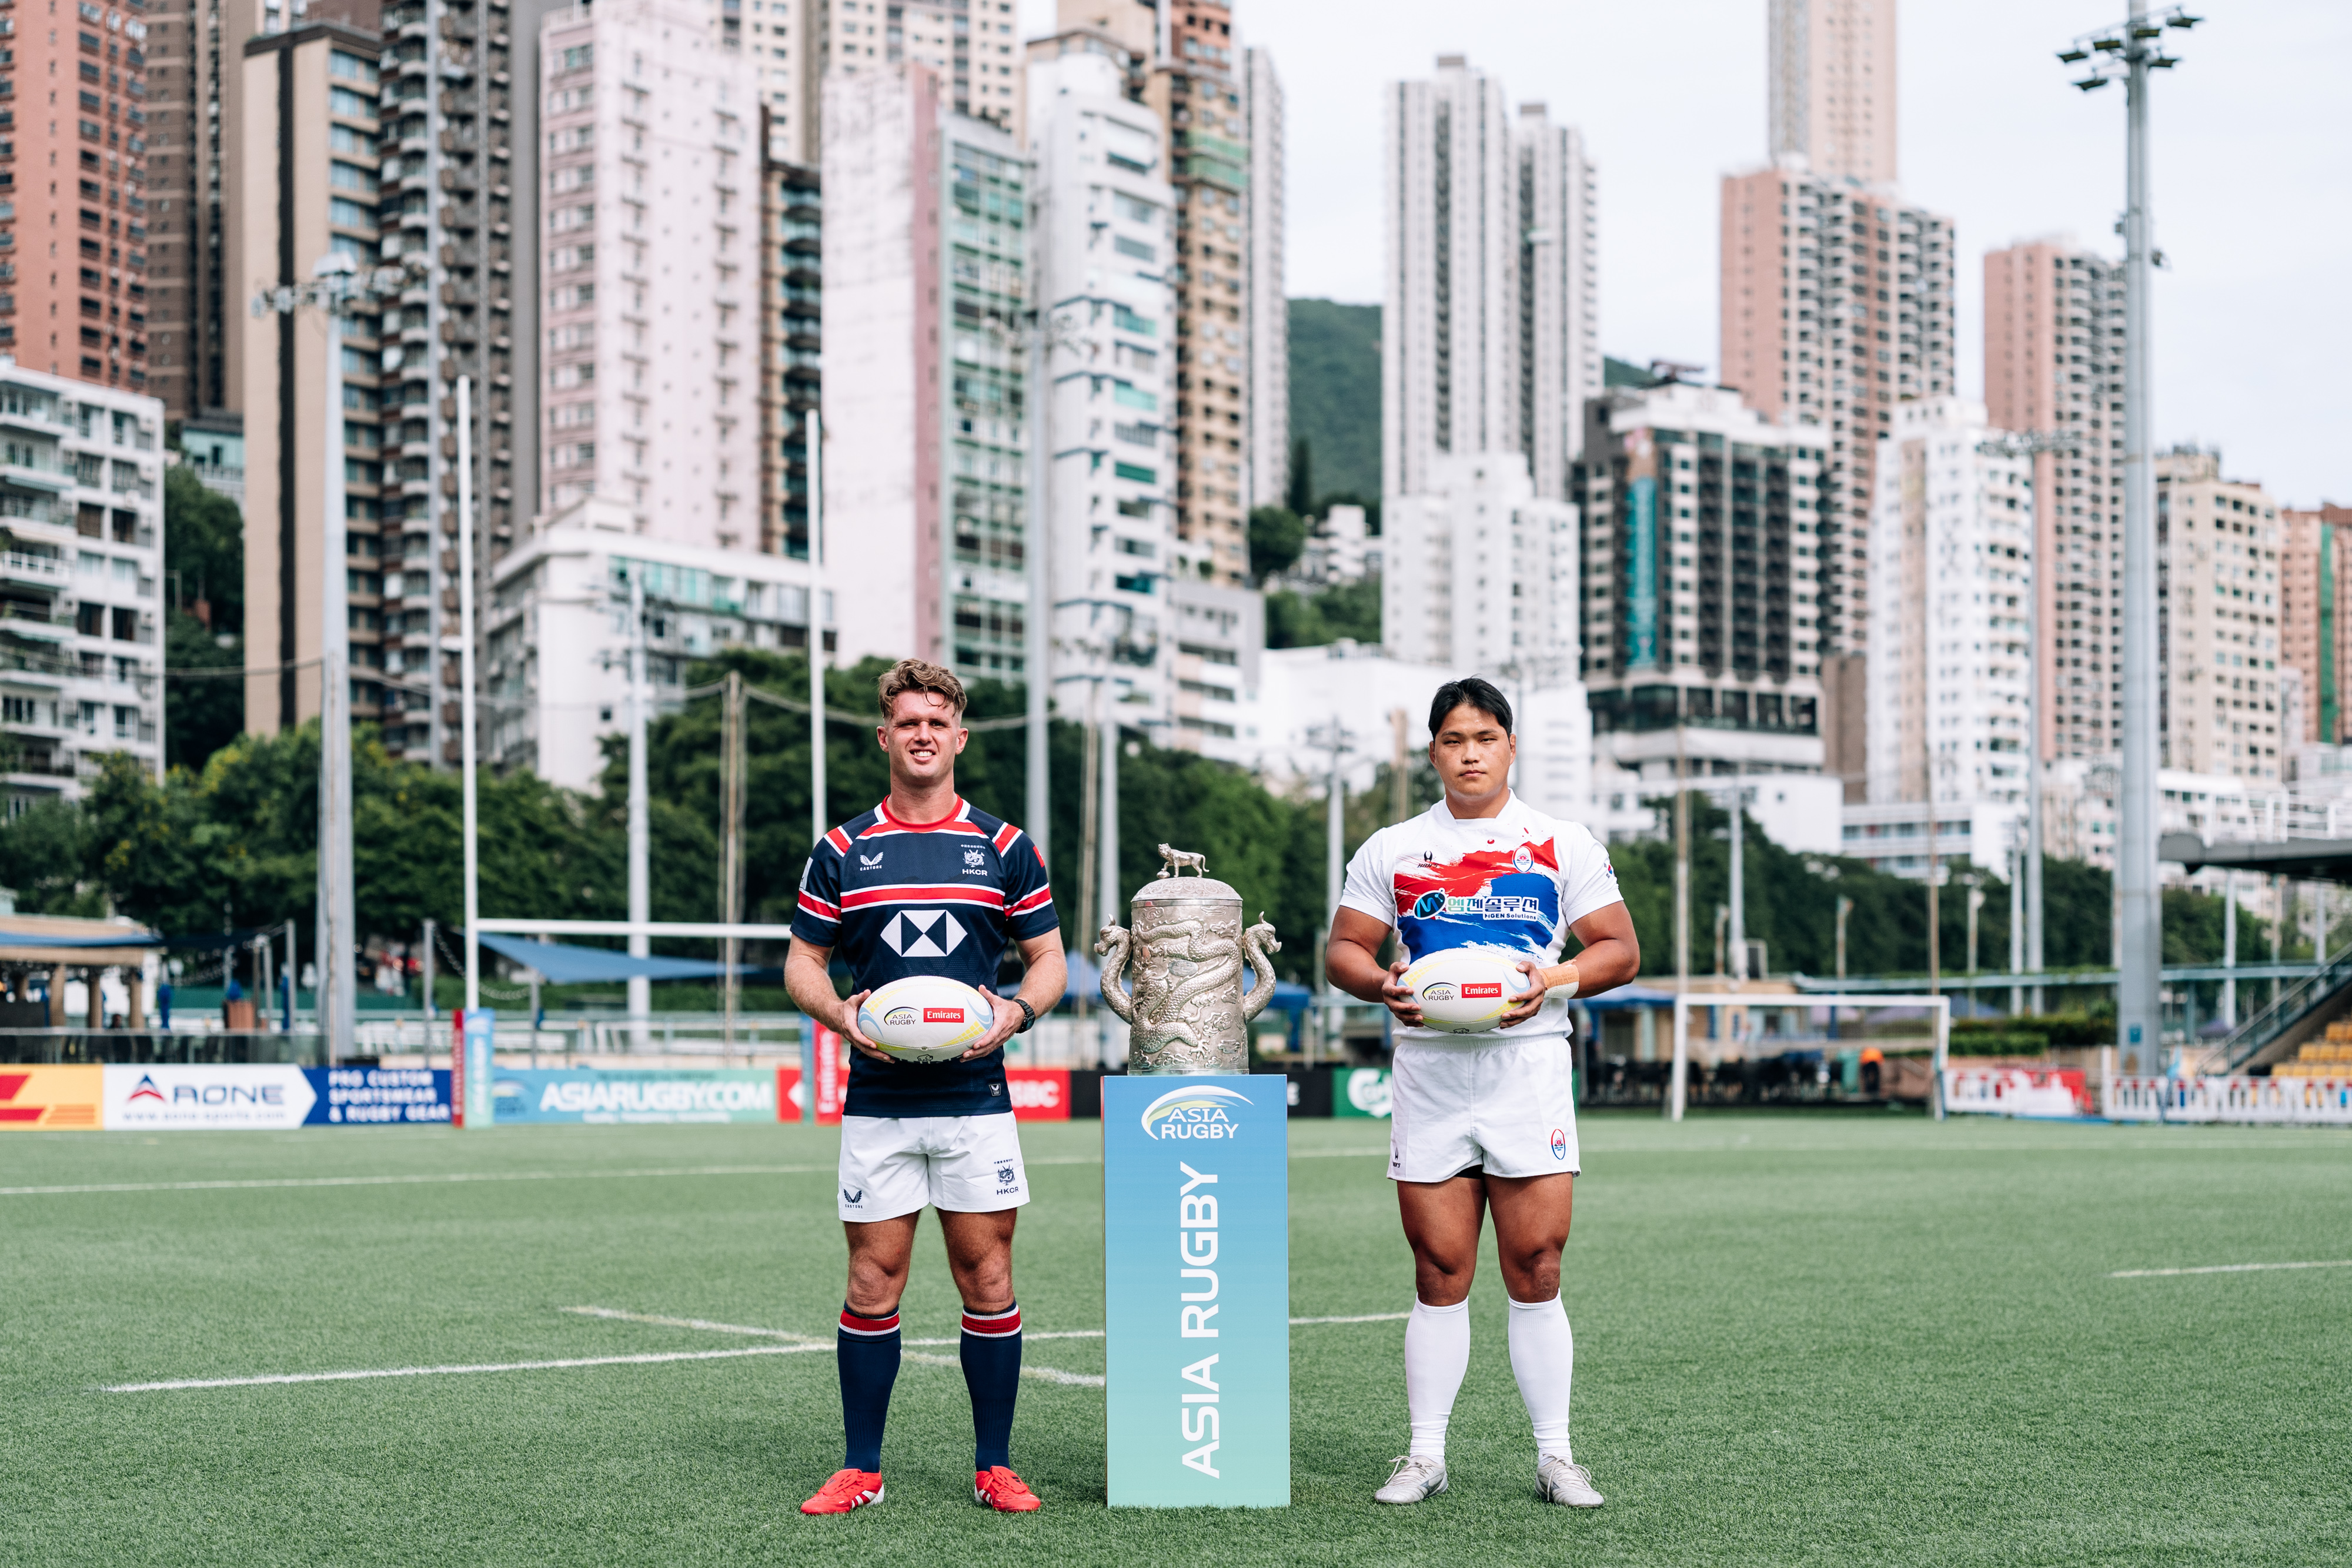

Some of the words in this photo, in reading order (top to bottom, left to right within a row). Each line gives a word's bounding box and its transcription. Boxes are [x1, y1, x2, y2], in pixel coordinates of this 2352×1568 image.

[1448, 898, 1537, 914] 엠젠솔루션
[927, 1011, 961, 1019] Emirates
[328, 1070, 363, 1087] PRO
[366, 1070, 433, 1087] CUSTOM
[328, 1087, 438, 1105] SPORTSWEAR
[345, 1104, 402, 1122] RUGBY
[405, 1104, 450, 1122] GEAR
[1167, 1108, 1230, 1122] ASIA
[1161, 1124, 1239, 1139] RUGBY
[996, 1186, 1019, 1195] HKCR
[1180, 1161, 1219, 1338] RUGBY
[1181, 1353, 1220, 1479] ASIA
